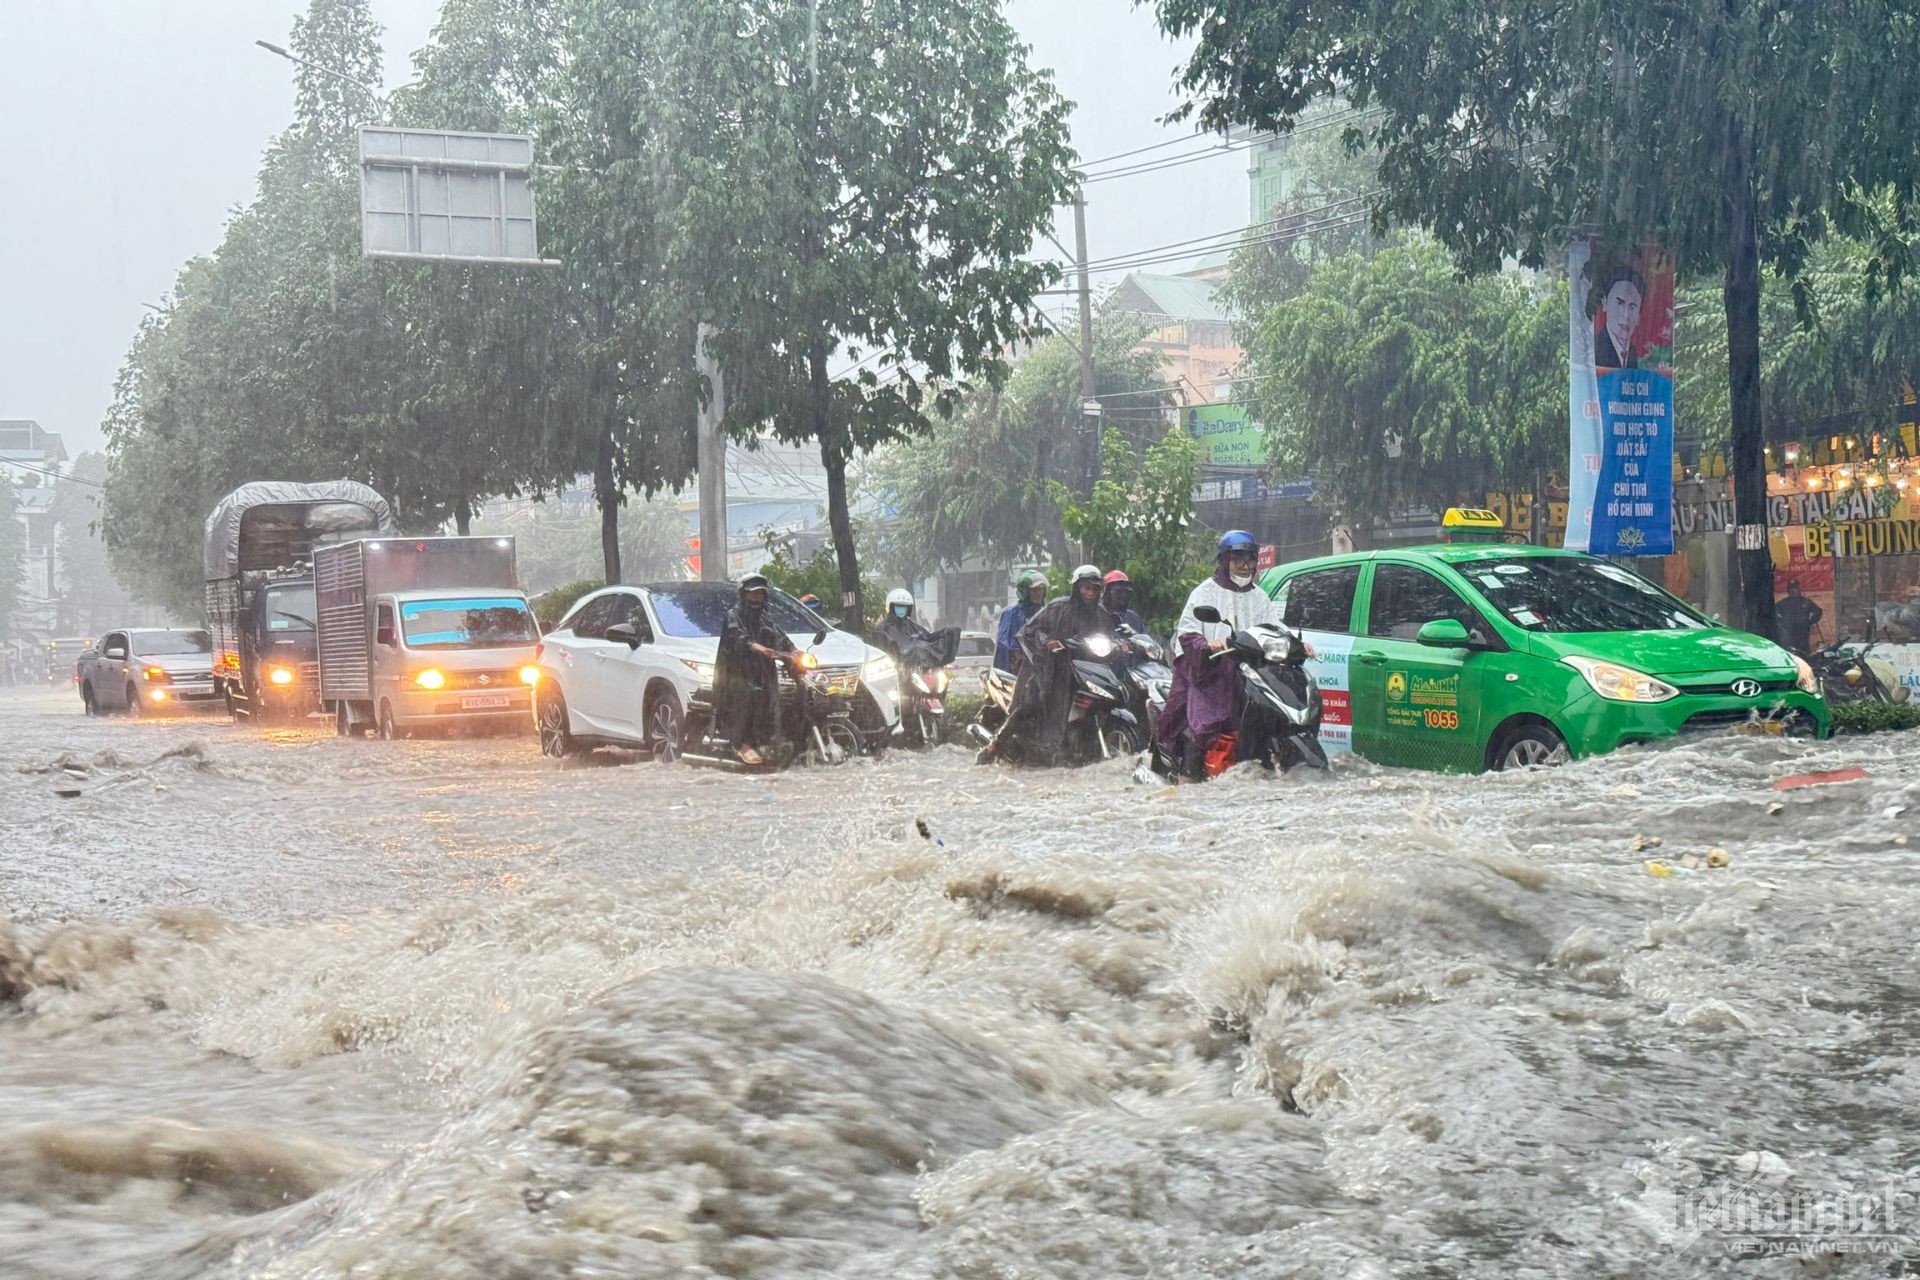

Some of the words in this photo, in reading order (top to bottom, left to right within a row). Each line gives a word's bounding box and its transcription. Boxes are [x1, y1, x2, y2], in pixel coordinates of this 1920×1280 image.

[1624, 458, 1639, 476] CỦA
[1804, 520, 1833, 559] BÊ
[1834, 520, 1892, 557] THUI
[1319, 676, 1339, 686] KHOA
[1424, 709, 1458, 729] 1055
